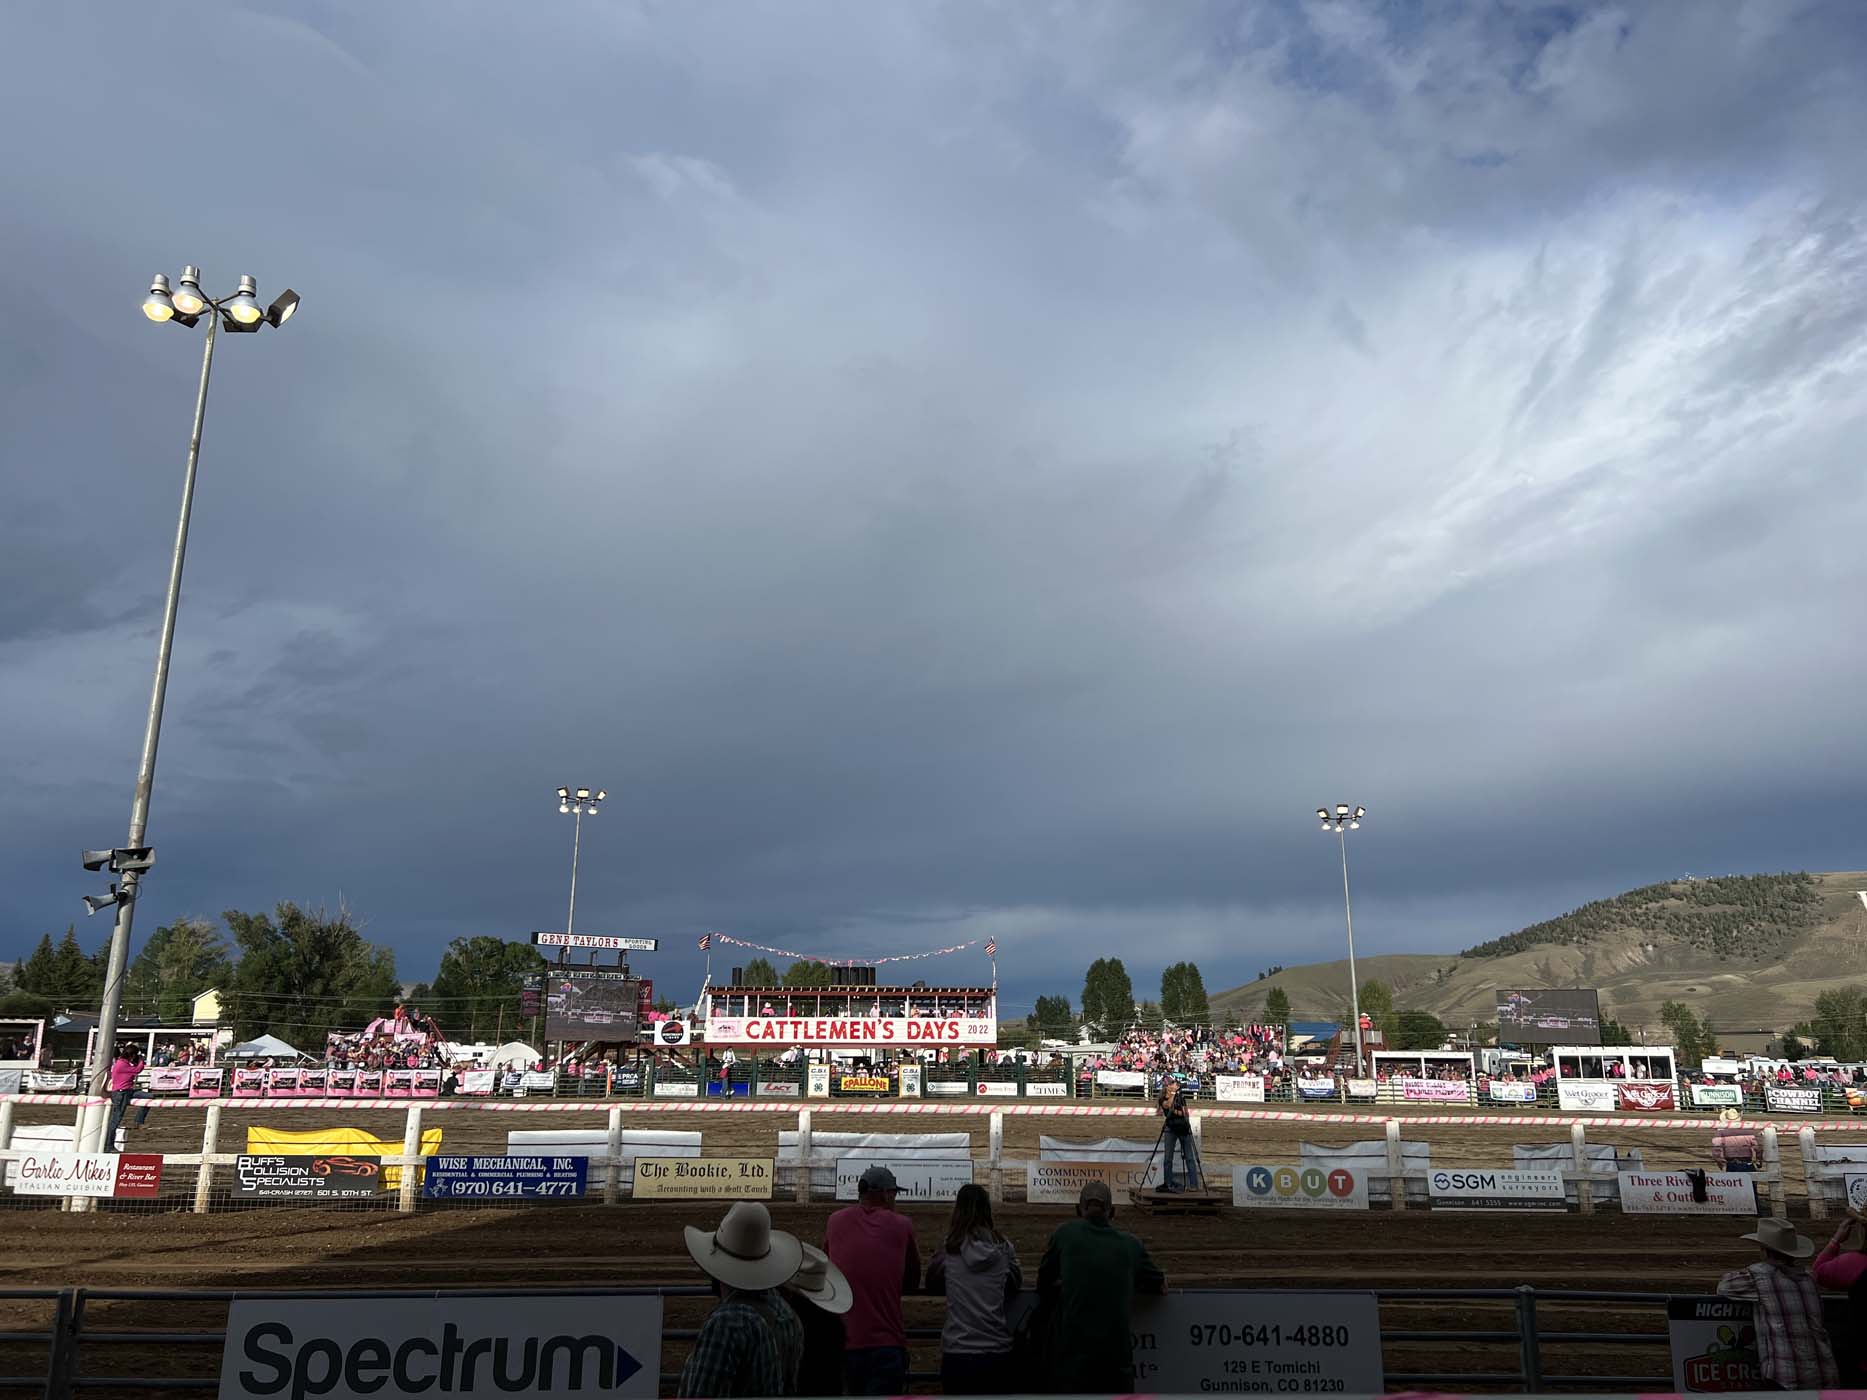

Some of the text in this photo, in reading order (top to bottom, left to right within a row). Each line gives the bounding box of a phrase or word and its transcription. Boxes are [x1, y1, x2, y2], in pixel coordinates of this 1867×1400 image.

[541, 934, 619, 948] GENE TAYLORS
[745, 1018, 894, 1040] CATTLEMEN'S
[907, 1020, 960, 1040] DAYS
[843, 1077, 887, 1089] SPALLONE
[1772, 1089, 1820, 1099] COWBOY
[1769, 1097, 1821, 1107] CHANNEL
[22, 1156, 111, 1182] Garlic Mike's
[238, 1156, 285, 1170] BUFF'S
[439, 1158, 574, 1172] WISE MECHANICAL, INC.
[240, 1167, 309, 1180] COLLISION
[640, 1162, 769, 1180] The Bookie, Ltd.
[1038, 1168, 1104, 1178] COMMUNITY
[19, 1182, 60, 1190] ITALIAN
[242, 1177, 325, 1191] SPECIALISTS
[451, 1180, 578, 1196] (970) 641-4771
[700, 1184, 716, 1193] with
[724, 1185, 741, 1193] Soft
[744, 1185, 768, 1193] Touch
[1452, 1174, 1496, 1190] SGM
[1502, 1184, 1558, 1192] surveyors
[1628, 1175, 1662, 1187] Three
[1705, 1176, 1744, 1188] Resort
[1653, 1191, 1663, 1202] &
[1189, 1324, 1349, 1348] 970-641-4880
[239, 1321, 615, 1400] Spectrum
[1223, 1360, 1320, 1374] 129 E Tomichi
[1694, 1363, 1720, 1384] ICE
[1200, 1379, 1344, 1393] Gunnison, CO 81230
